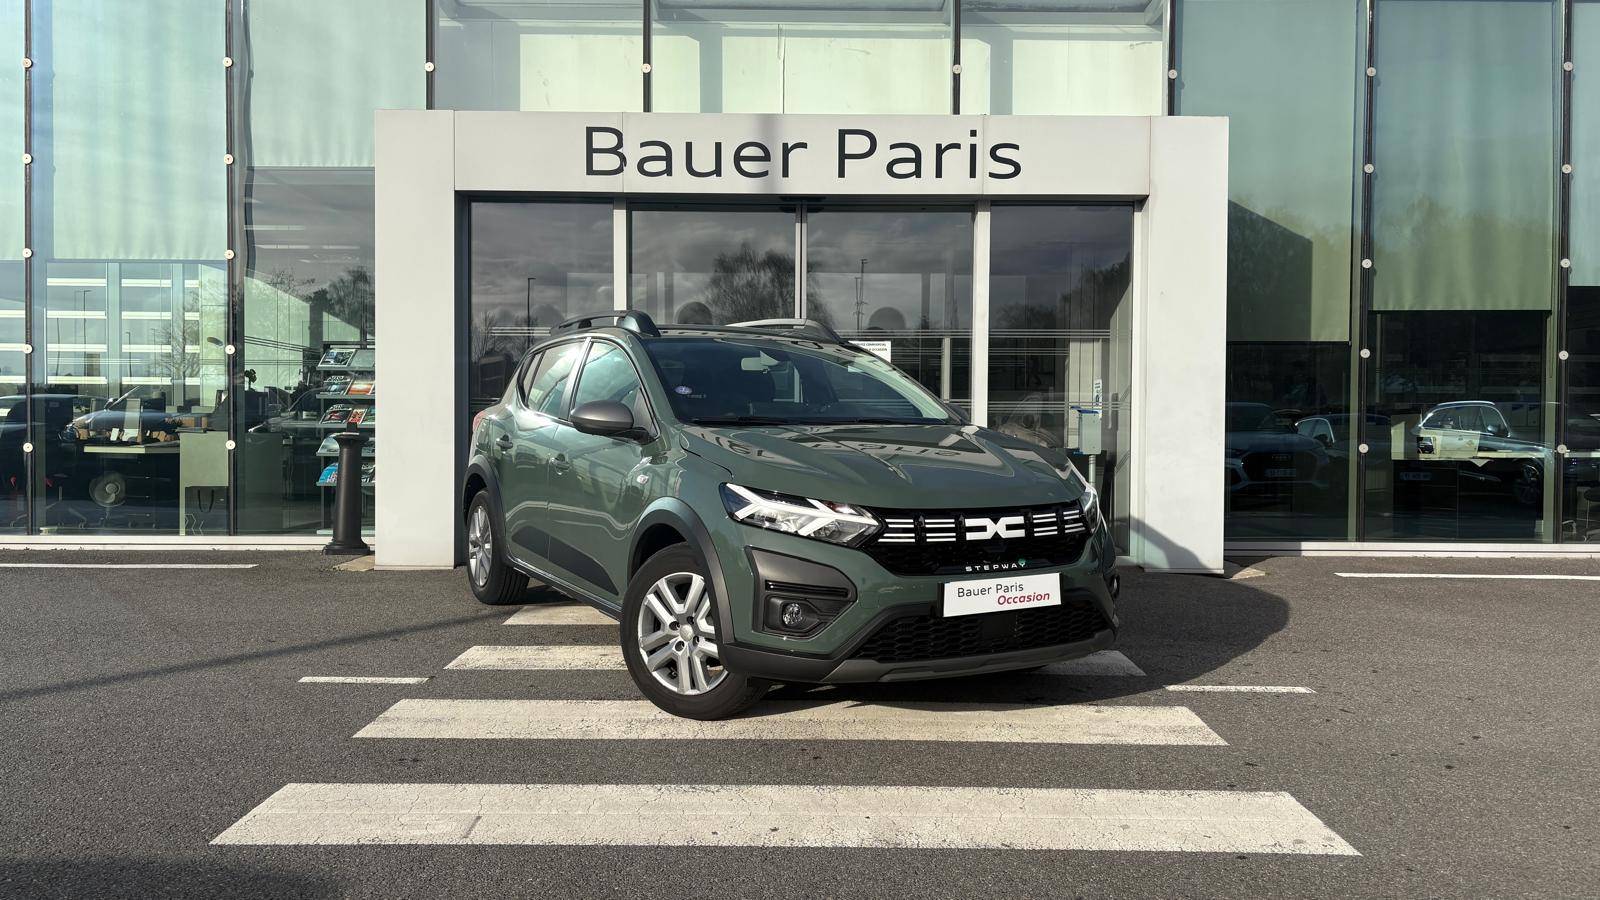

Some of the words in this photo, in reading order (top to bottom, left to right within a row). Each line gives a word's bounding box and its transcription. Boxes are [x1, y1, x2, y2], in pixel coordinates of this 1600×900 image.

[586, 126, 808, 178] Bauer
[838, 128, 1022, 180] Paris
[965, 560, 1026, 572] STEPWAY
[957, 586, 992, 598] Bauer
[995, 582, 1024, 594] Paris
[997, 592, 1050, 606] Occasion
